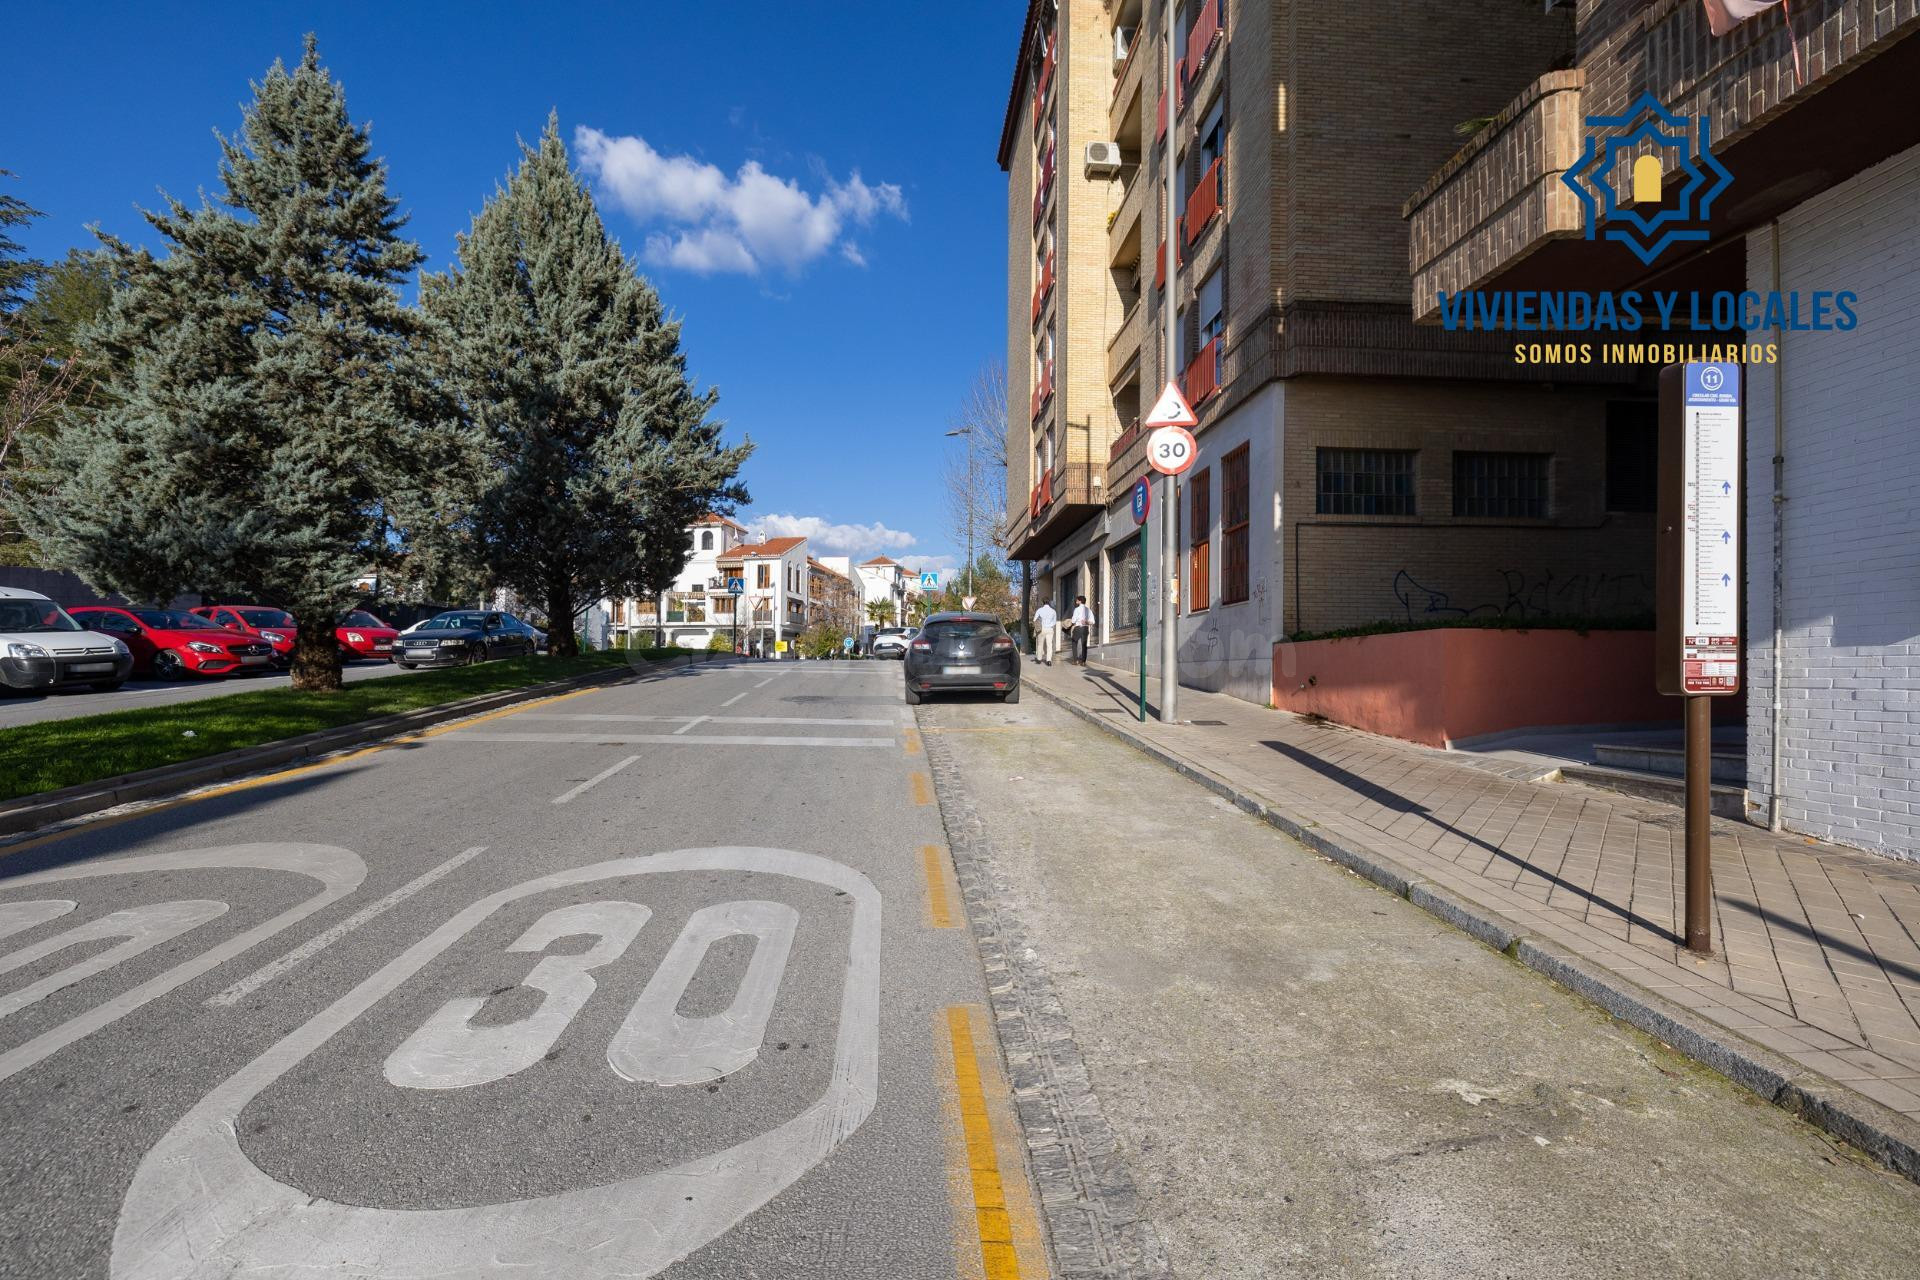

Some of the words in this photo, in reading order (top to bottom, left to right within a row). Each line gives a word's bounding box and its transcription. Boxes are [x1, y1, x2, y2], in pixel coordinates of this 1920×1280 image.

[1705, 374, 1718, 384] 11
[1159, 442, 1185, 458] 30
[383, 900, 799, 1089] 30
